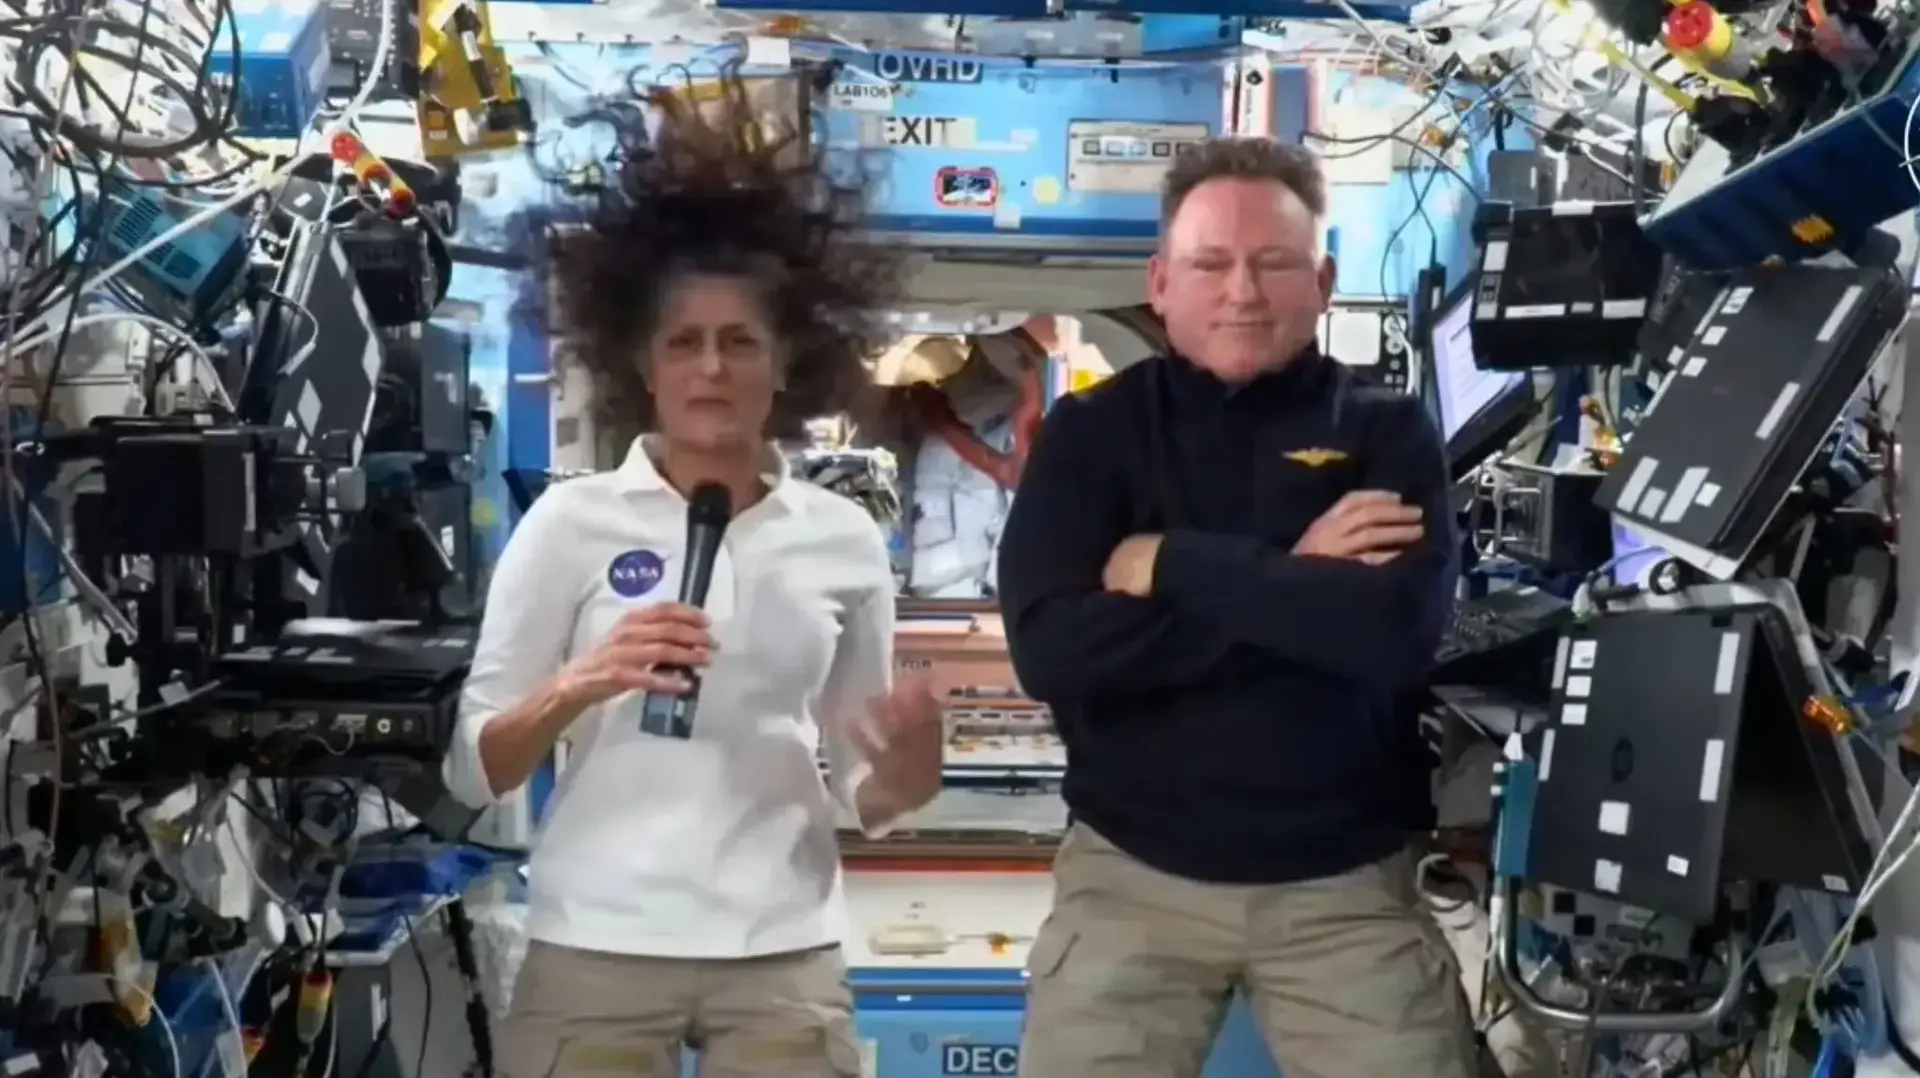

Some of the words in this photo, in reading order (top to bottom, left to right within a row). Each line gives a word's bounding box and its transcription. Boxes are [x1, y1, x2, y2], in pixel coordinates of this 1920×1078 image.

[878, 53, 980, 82] OVHD
[884, 116, 957, 145] EXIT
[612, 566, 660, 581] NASA
[947, 1046, 1017, 1074] DEC
